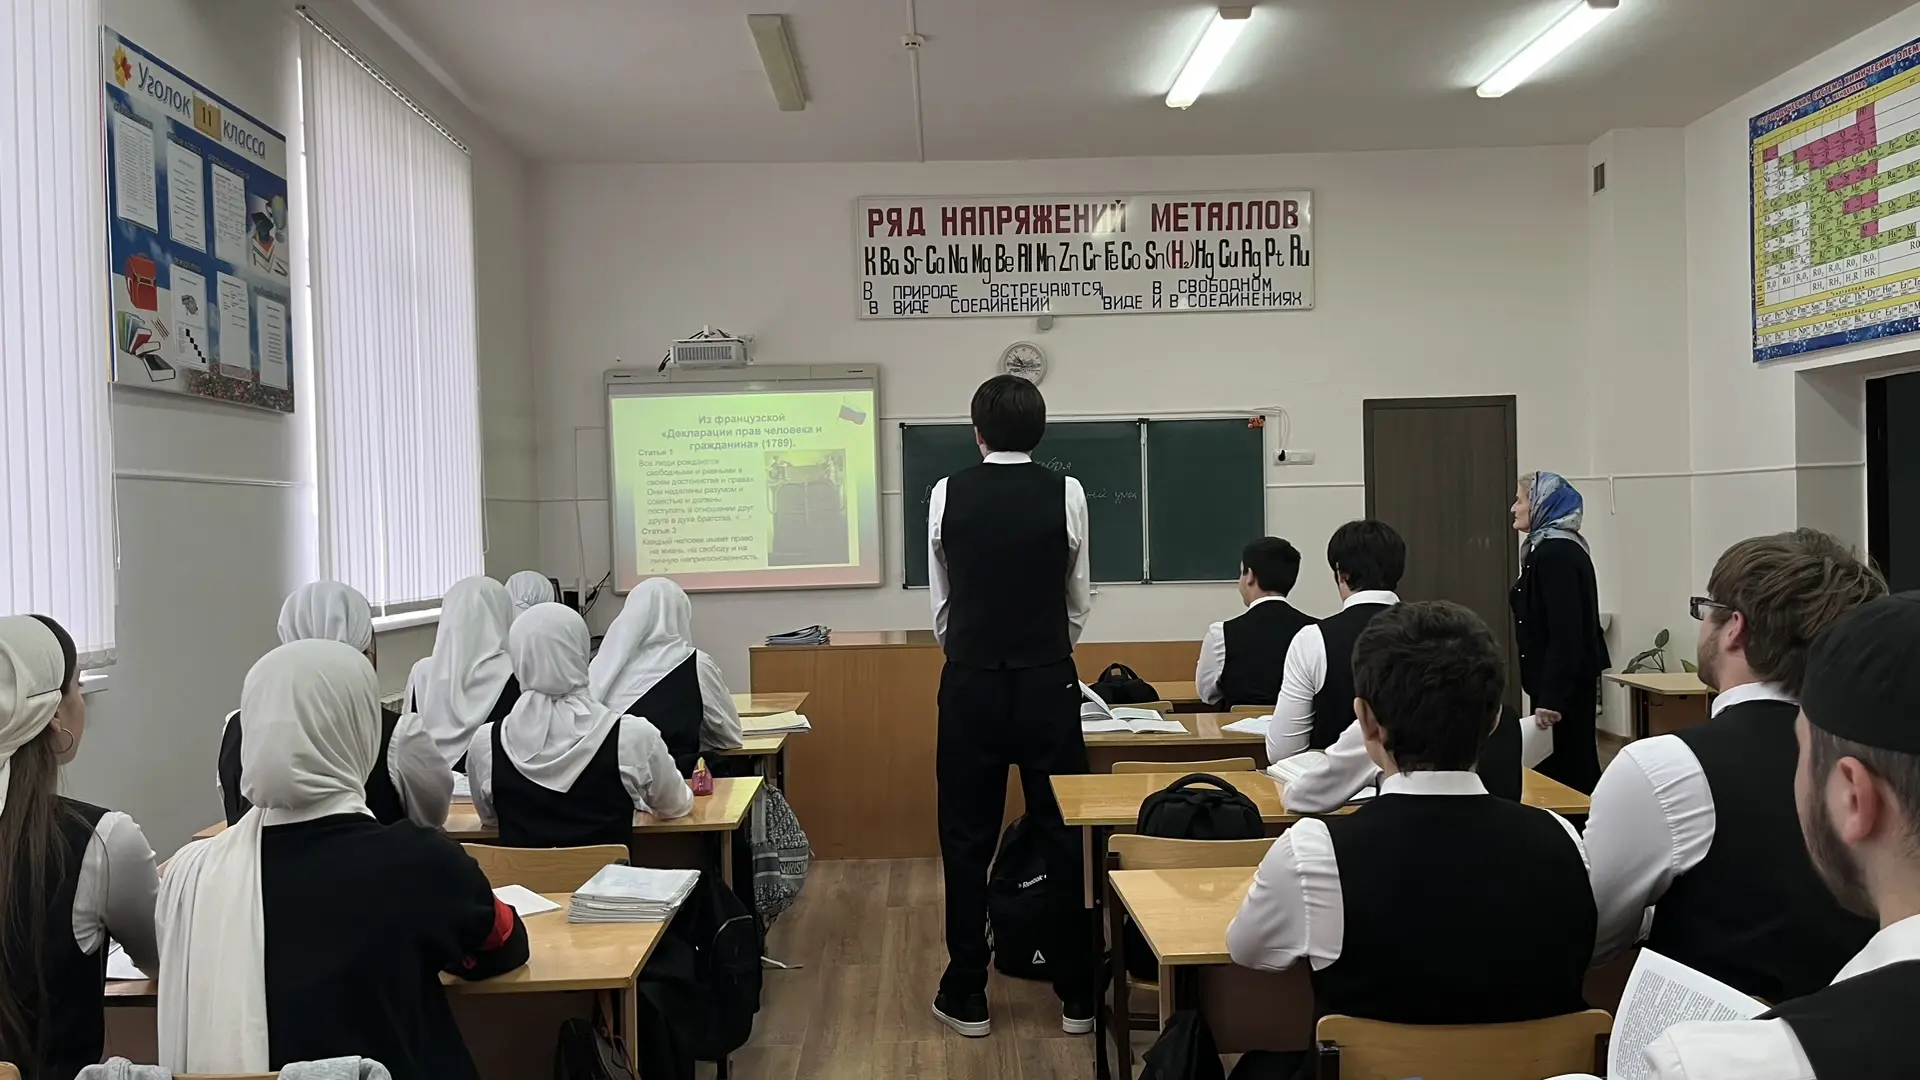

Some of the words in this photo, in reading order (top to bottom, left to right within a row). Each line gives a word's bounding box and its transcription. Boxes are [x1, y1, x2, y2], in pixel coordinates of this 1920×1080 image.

[1812, 80, 1843, 101] СИСТЕМА
[1843, 56, 1897, 85] ХИМИЧЕСКИХ
[138, 62, 191, 117] Уголок
[202, 107, 212, 127] 11
[223, 120, 266, 160] класса
[868, 207, 926, 238] РЯД
[941, 200, 1126, 236] НАПРЯЖЕНИЙ
[1151, 200, 1299, 232] МЕТАЛЛОВ
[880, 246, 899, 276] Ba
[903, 245, 923, 275] Sr
[926, 245, 945, 274] Ca
[948, 244, 968, 274] Na
[972, 244, 991, 284] Mg
[995, 243, 1014, 273] Be
[1018, 243, 1032, 272] Al
[1036, 242, 1056, 272] Mn
[1059, 242, 1079, 271] Zn
[1083, 241, 1102, 271] Cr
[1104, 241, 1119, 271] Fe
[1121, 241, 1141, 270] Co
[1219, 239, 1238, 268] Cu
[1241, 238, 1261, 278] Ag
[1265, 237, 1284, 267] Pt
[1290, 234, 1309, 267] Au
[1864, 267, 1876, 277] HR
[863, 281, 873, 300] В
[893, 284, 958, 300] ПРИРОДЕ
[1152, 280, 1162, 295] В
[1178, 277, 1272, 293] СВОБОДНОМ
[869, 300, 879, 315] В
[893, 299, 929, 315] ВИДЕ
[950, 296, 1050, 314] СОЕДИНЕНИЙ
[1103, 295, 1143, 310] ВИДЕ
[1152, 294, 1162, 309] И
[1169, 294, 1179, 308] В
[1188, 291, 1302, 308] СОЕДИНЕНИЯХ
[699, 414, 712, 425] Из
[714, 412, 786, 426] французской
[661, 428, 733, 440] «Декларации
[735, 428, 761, 438] прав
[764, 426, 813, 436] человека
[815, 426, 822, 434] и
[638, 449, 667, 457] Статья
[689, 441, 759, 452] гражданина»
[641, 527, 670, 535] Статья
